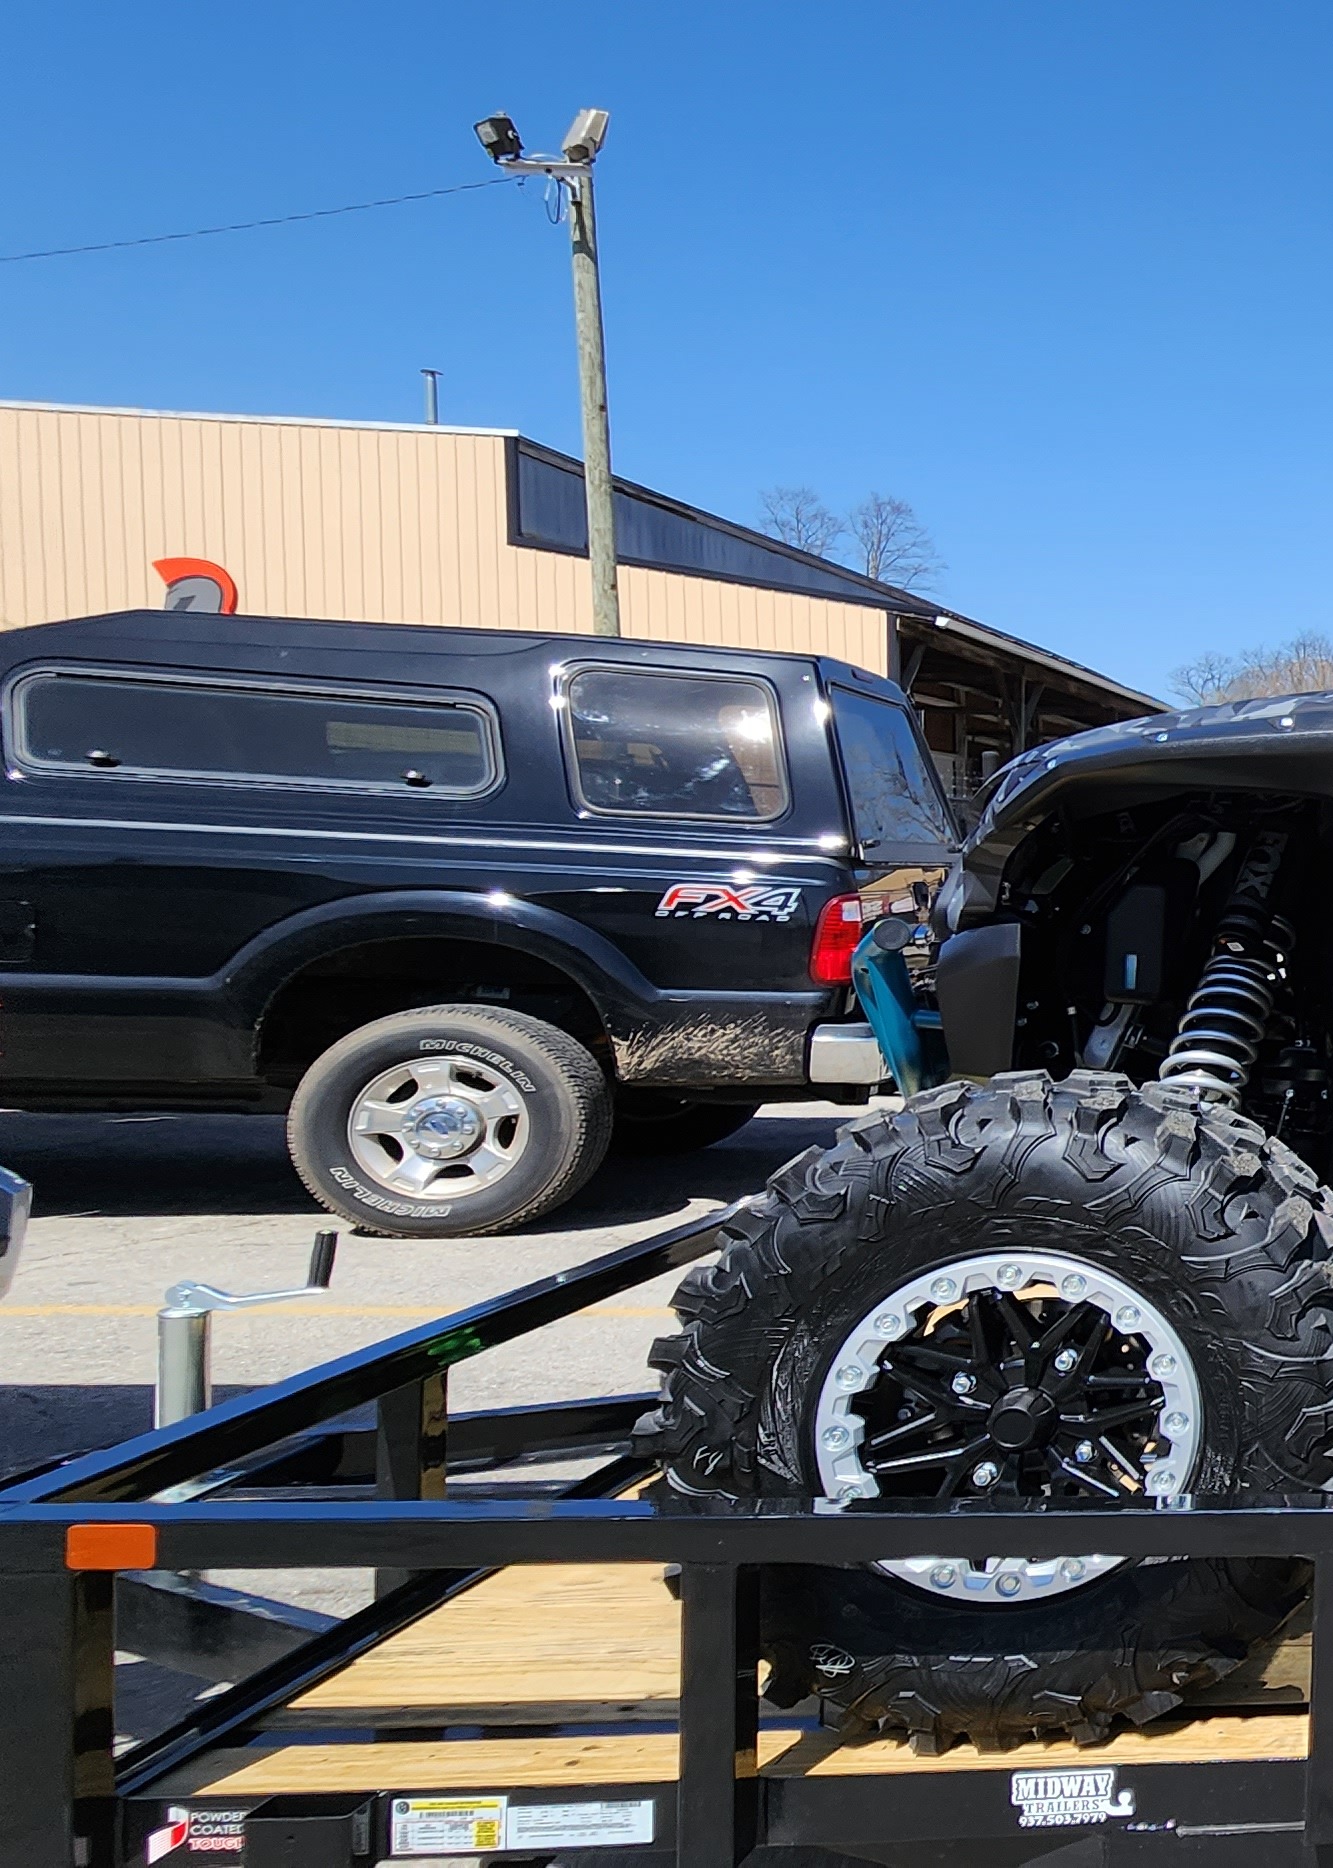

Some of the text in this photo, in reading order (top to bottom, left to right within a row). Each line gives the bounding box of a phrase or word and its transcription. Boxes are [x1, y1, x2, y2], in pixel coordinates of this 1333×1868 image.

[1234, 831, 1289, 898] FOX
[656, 882, 802, 916] FX4
[654, 910, 791, 922] OFF ROAD
[419, 1039, 536, 1093] MICHELIN
[329, 1166, 451, 1218] MICHELIN
[1016, 1773, 1110, 1801] MIDWAY
[1018, 1813, 1107, 1827] 937.503.7979
[1025, 1799, 1101, 1814] TRAILERS
